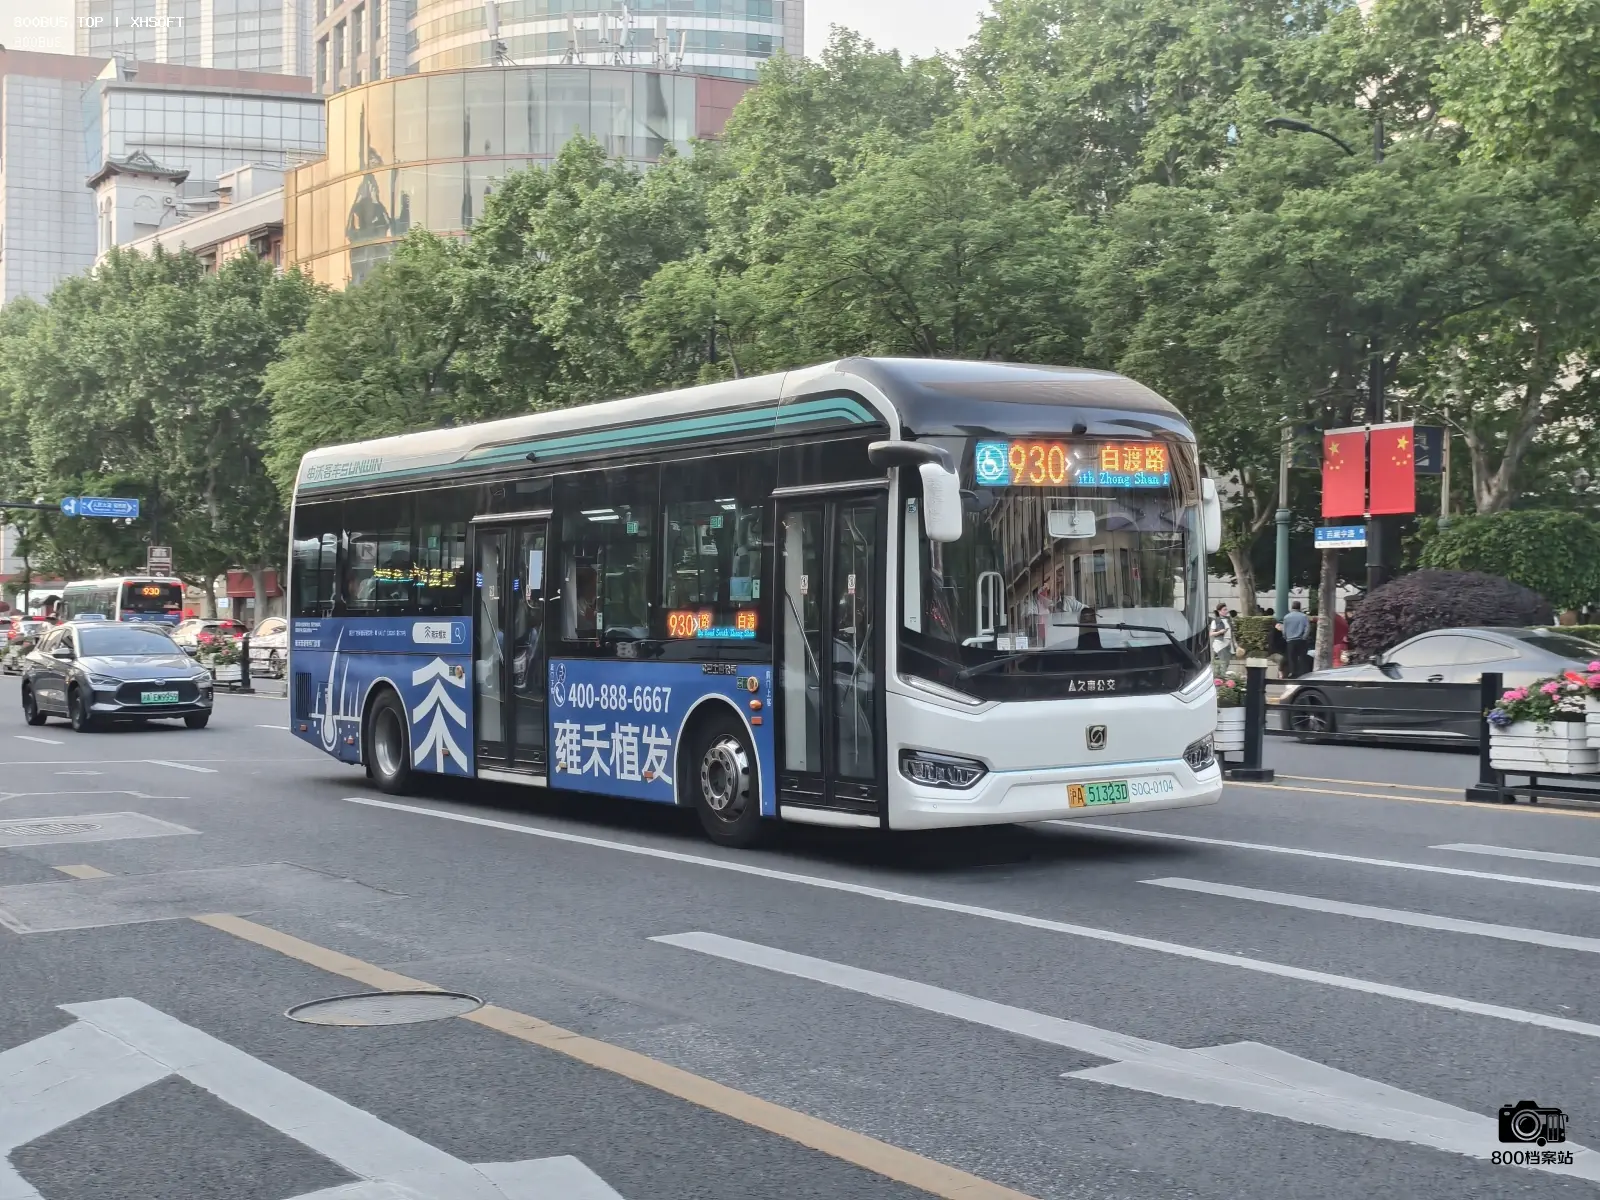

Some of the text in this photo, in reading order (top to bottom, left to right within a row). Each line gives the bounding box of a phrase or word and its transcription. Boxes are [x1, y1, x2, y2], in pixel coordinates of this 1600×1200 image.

[1008, 444, 1065, 484] 930
[1101, 446, 1166, 472] 白渡路
[1099, 472, 1131, 487] Zhong
[1134, 472, 1160, 486] Shan
[143, 587, 160, 596] 930
[668, 613, 694, 637] 930
[568, 683, 672, 713] 400-888-6667
[553, 719, 673, 785] 雍禾植发
[1088, 783, 1128, 802] 51323D
